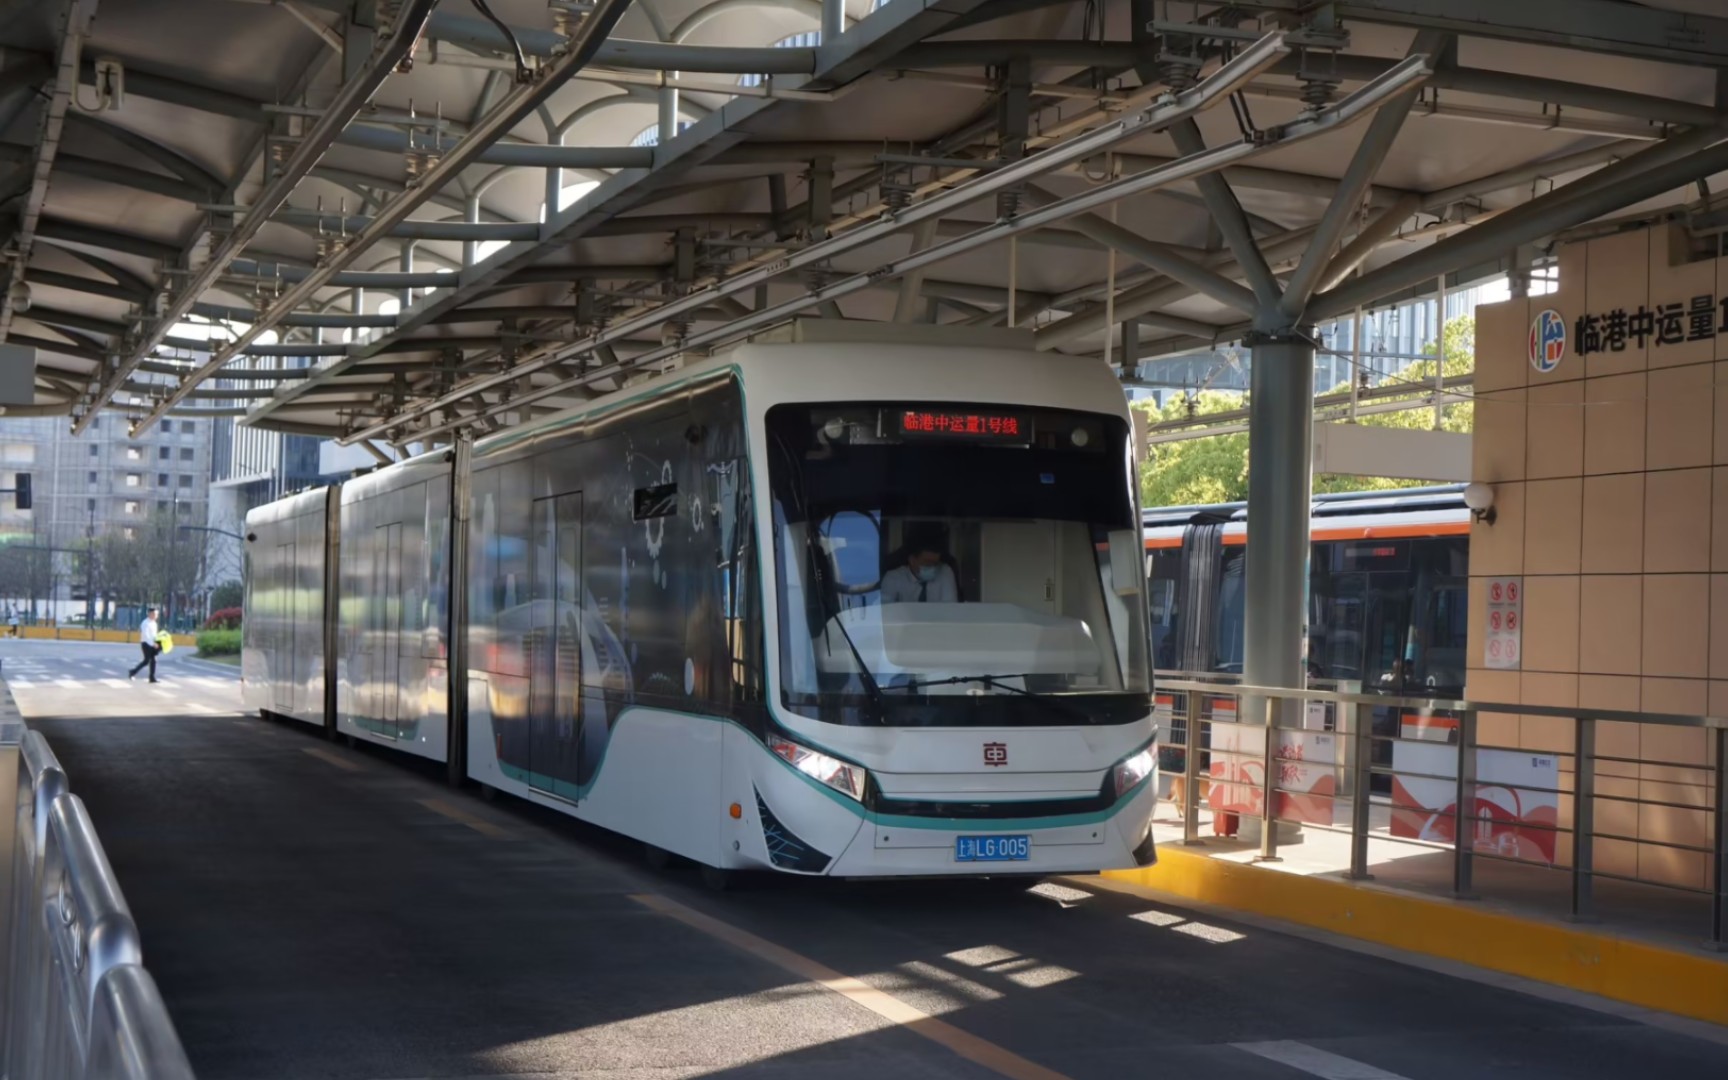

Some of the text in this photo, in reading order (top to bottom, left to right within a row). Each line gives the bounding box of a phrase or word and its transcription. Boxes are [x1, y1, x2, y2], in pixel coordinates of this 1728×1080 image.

[904, 412, 1018, 434] 临港中运量1号线
